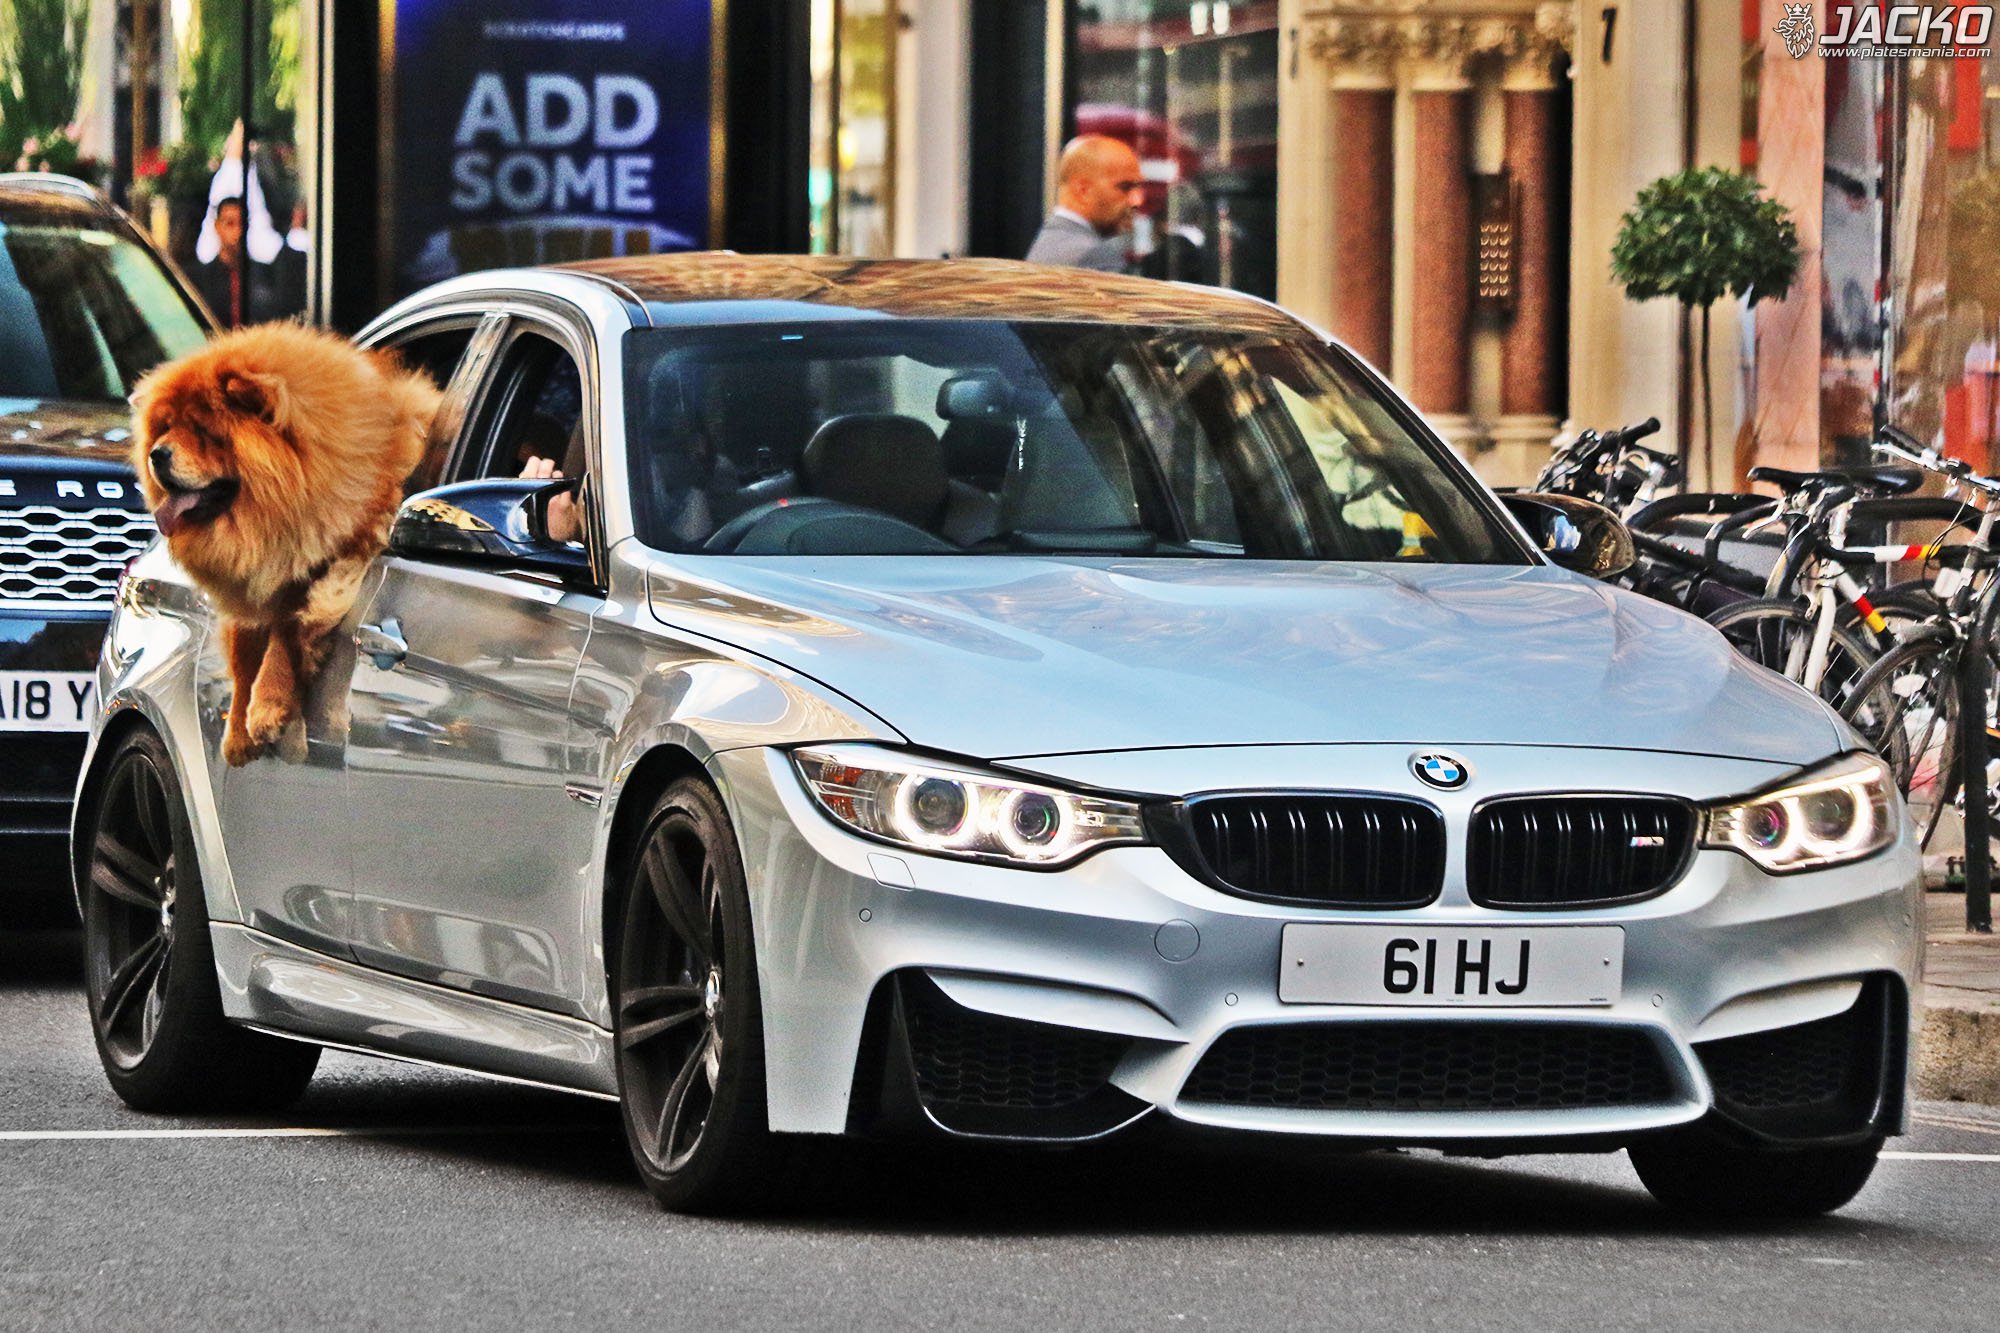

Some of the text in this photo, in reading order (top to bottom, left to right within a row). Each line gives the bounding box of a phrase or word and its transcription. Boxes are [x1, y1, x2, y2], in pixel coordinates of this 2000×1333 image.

[454, 71, 660, 147] ADD
[453, 152, 655, 211] SOME
[56, 480, 145, 499] RO
[0, 680, 51, 720] 18
[1383, 938, 1531, 995] 61 HJ
